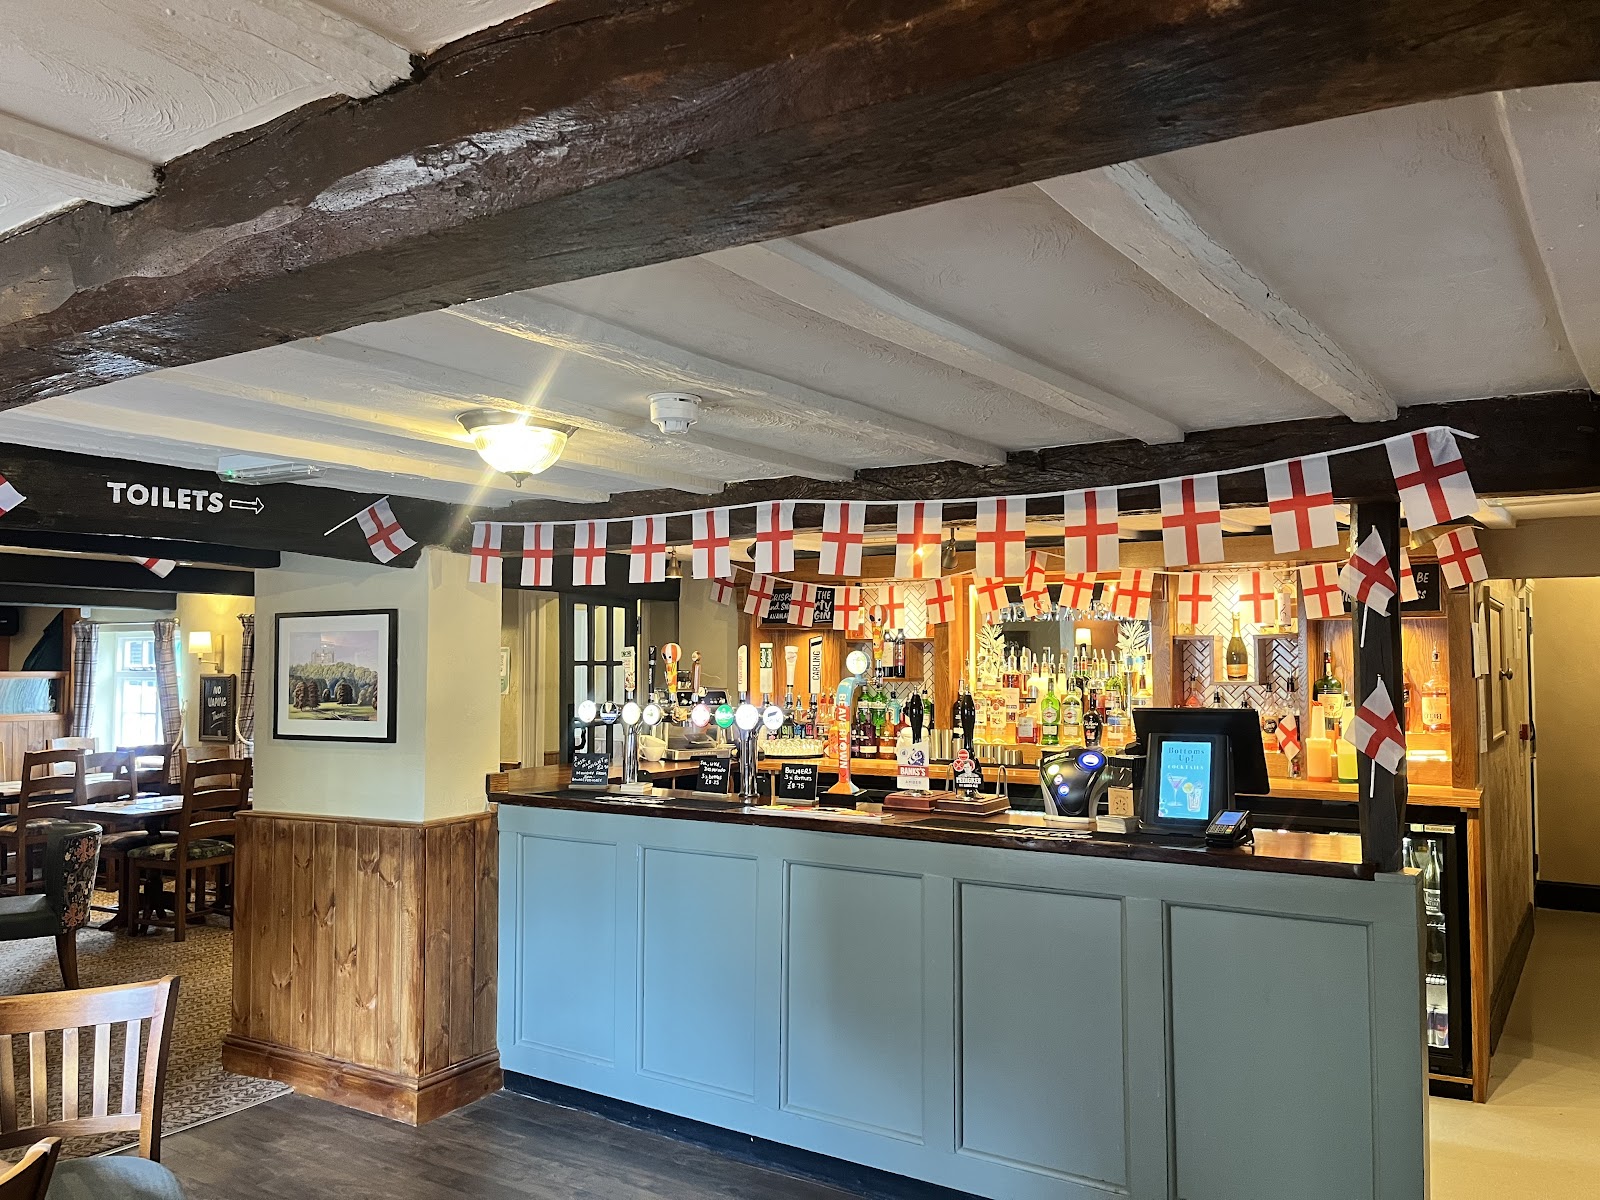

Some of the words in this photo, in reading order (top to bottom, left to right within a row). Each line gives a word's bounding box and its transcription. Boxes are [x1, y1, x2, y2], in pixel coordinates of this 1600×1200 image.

[106, 481, 224, 513] TOILETS
[1416, 571, 1430, 583] BE
[817, 590, 832, 600] THE
[813, 610, 831, 620] GIN
[812, 650, 821, 681] CARLING
[212, 685, 222, 695] NO
[207, 696, 227, 707] VAPING
[838, 693, 848, 769] BEAVERTOWN
[1168, 747, 1205, 755] Bottoms
[1178, 754, 1194, 763] Up!
[900, 766, 926, 777] BANKS'S
